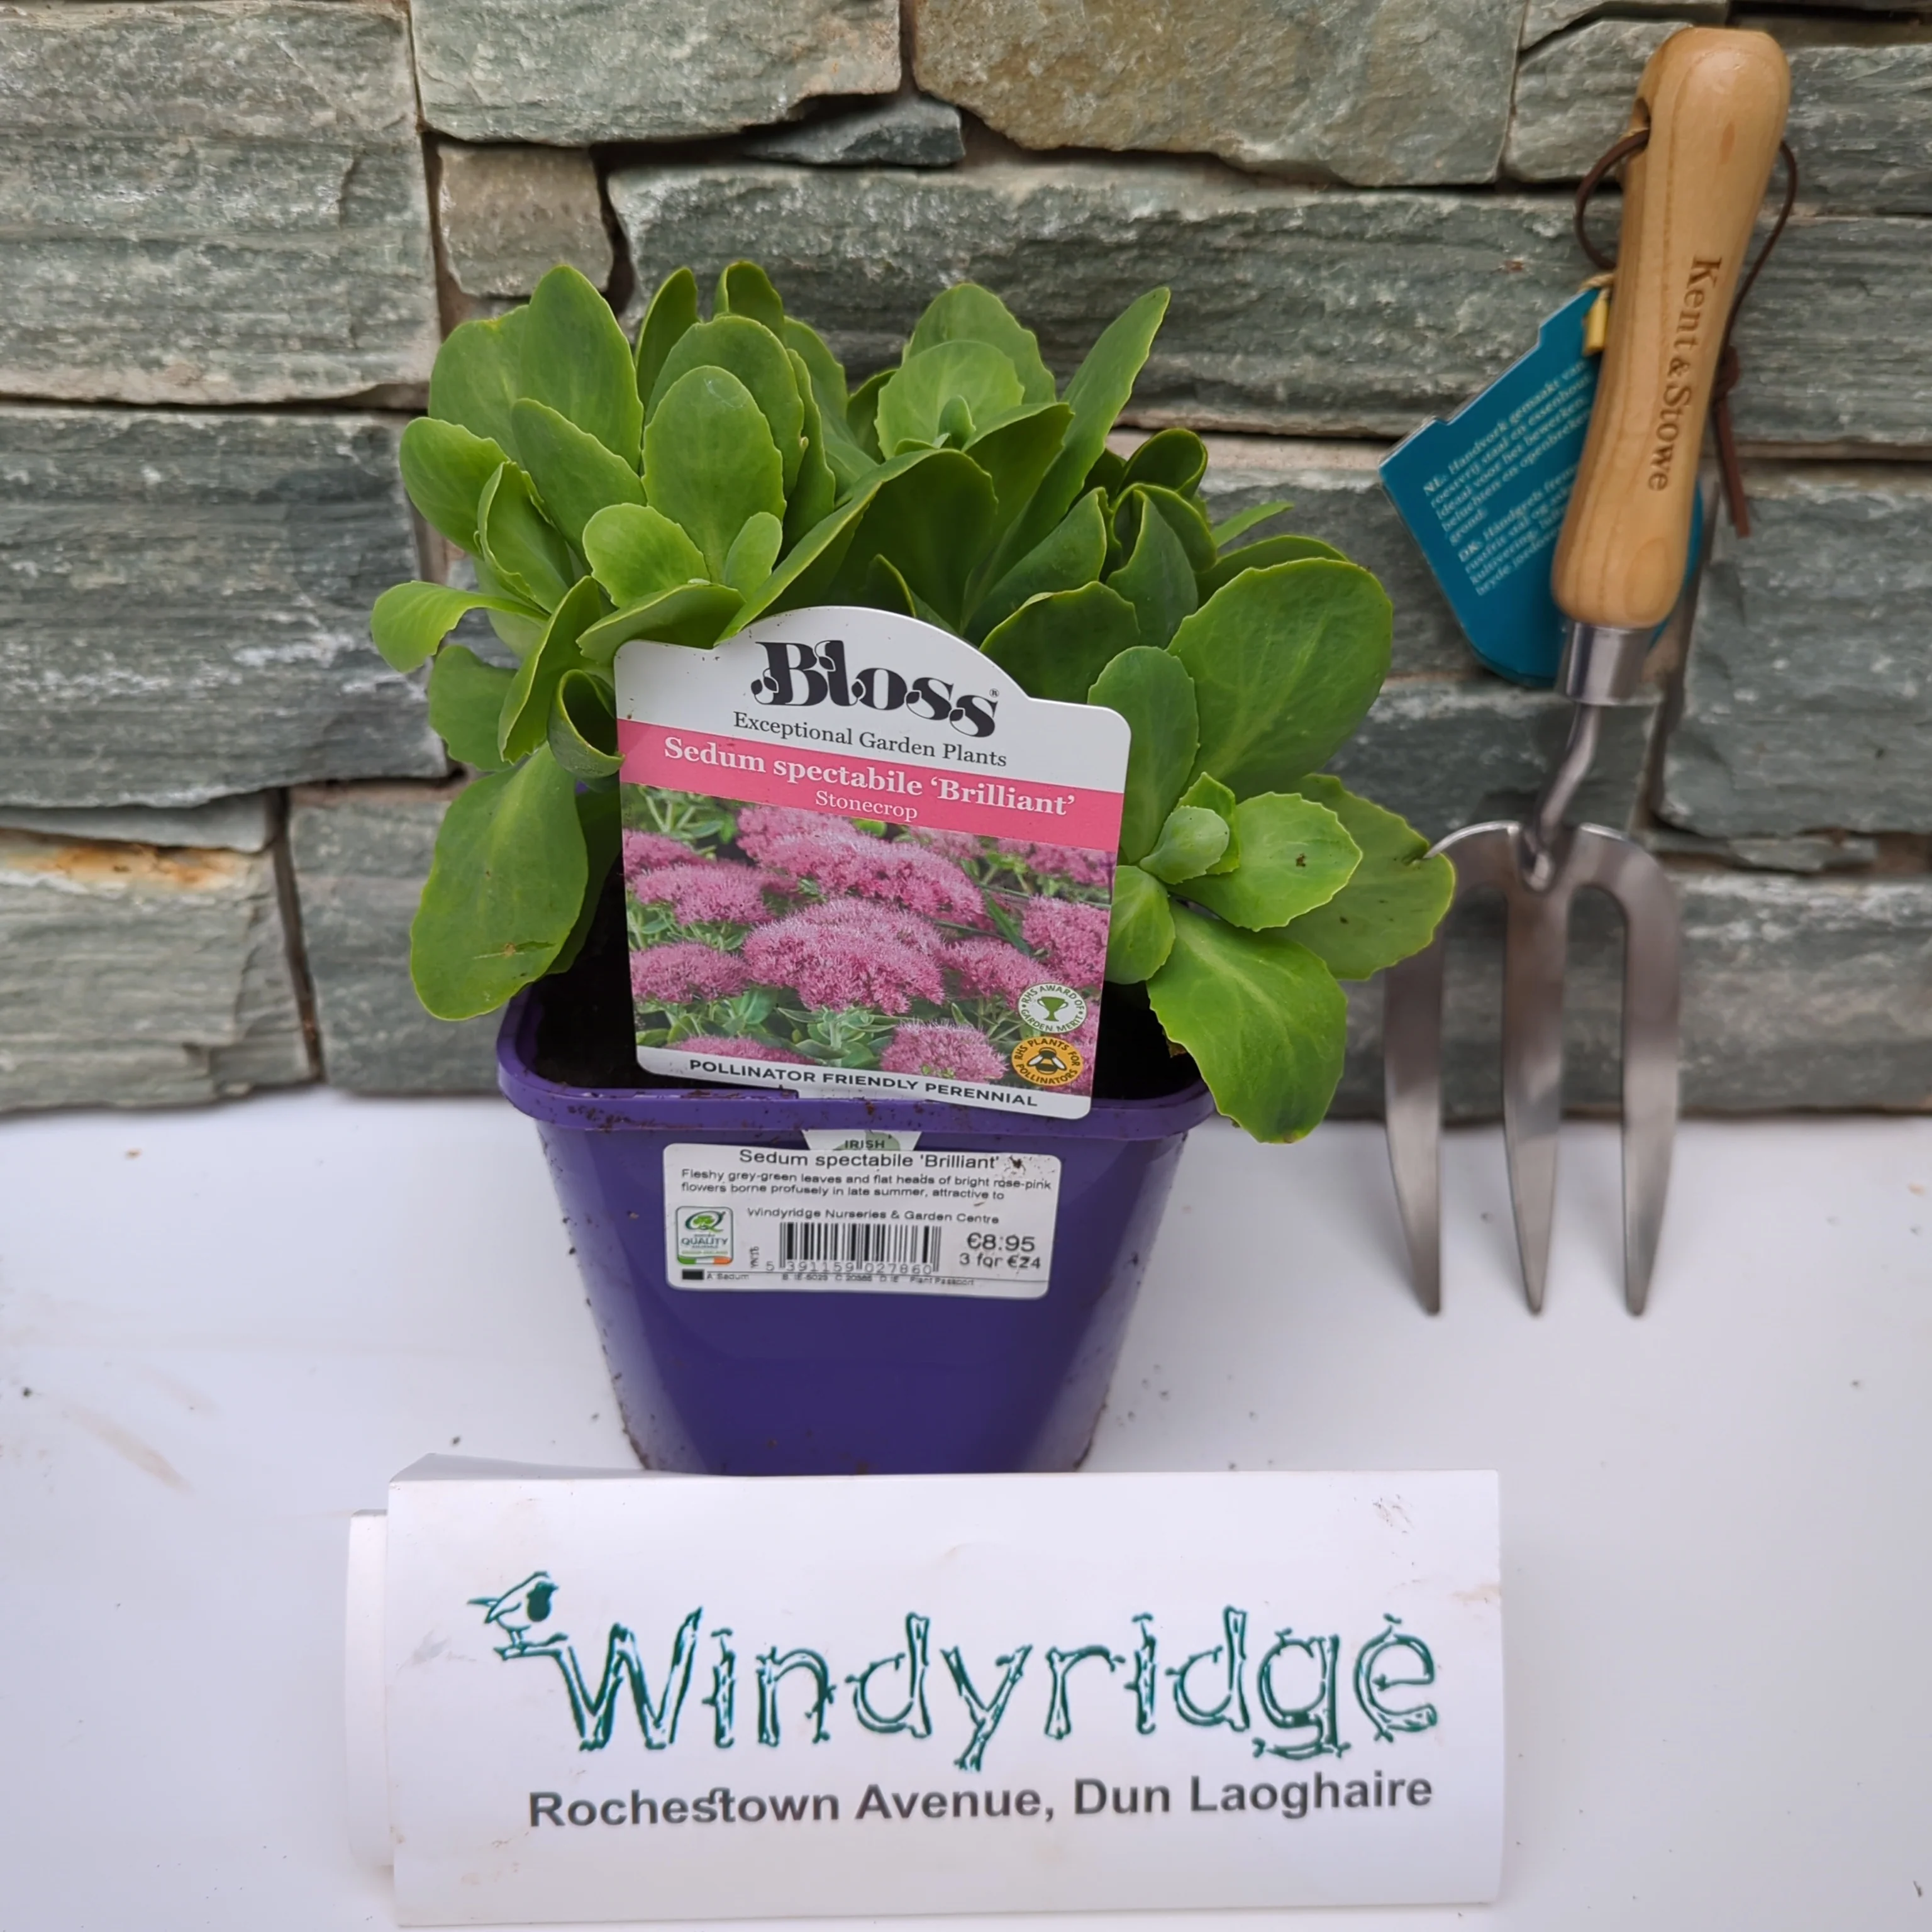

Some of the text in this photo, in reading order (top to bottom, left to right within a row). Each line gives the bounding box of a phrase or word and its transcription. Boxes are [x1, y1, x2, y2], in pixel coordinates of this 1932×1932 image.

[1648, 257, 1722, 492] Kent & Stowe
[733, 711, 1007, 767] Exceptional Garden Plants
[664, 737, 766, 774] Sedum
[773, 760, 923, 796] spectabile
[815, 790, 918, 821] Stonecrop
[1021, 985, 1084, 1010] RHS AWARD OF
[1021, 1009, 1084, 1032] GARDEN MERIT
[1014, 1038, 1080, 1067] RHS PLANTS FOR
[690, 1058, 1038, 1108] POLLINATOR FRIENDLY PERENNIAL
[1016, 1063, 1078, 1085] POLLINATORS
[845, 1139, 886, 1150] IRISH
[740, 1148, 999, 1170] Sedum spectabile 'Brilliant'
[682, 1169, 1052, 1191] Fleshy grey-green leaves and flat heads of bright rose-pink
[682, 1182, 1004, 1200] flowers borne profusely in late summer, attractive to
[748, 1207, 999, 1224] Windyridge Nurseries & Garden Centre
[681, 1237, 728, 1246] QUALITY
[766, 1261, 775, 1271] 5
[959, 1253, 1041, 1269] 3 for €24
[553, 1604, 1438, 1772] Windyridge
[527, 1770, 1434, 1829] Rochestown Avenue, Dun Laoghaire
